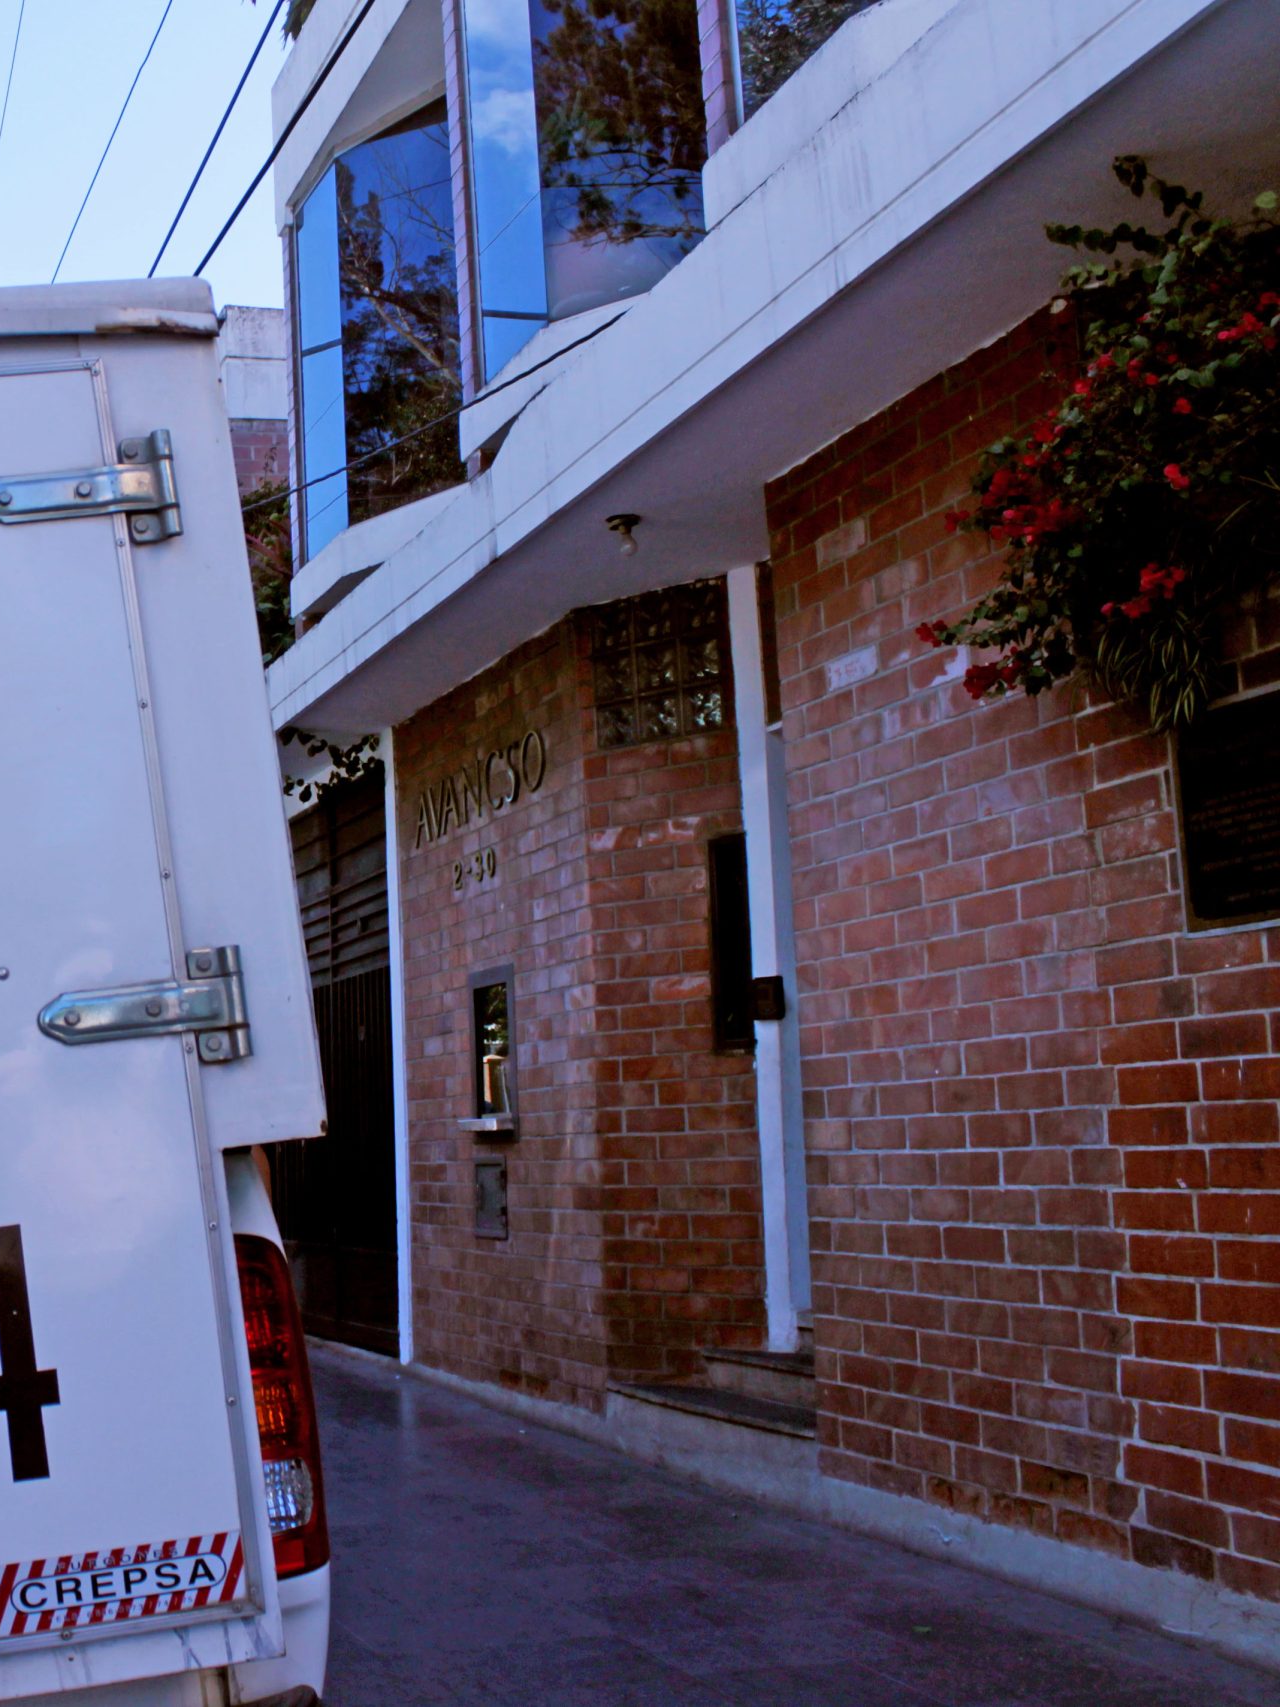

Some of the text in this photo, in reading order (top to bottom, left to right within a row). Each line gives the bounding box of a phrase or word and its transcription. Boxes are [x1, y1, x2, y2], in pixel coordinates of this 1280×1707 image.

[416, 730, 546, 849] AVANCSO
[453, 848, 496, 891] 2-30
[20, 1558, 216, 1608] CREPSA
